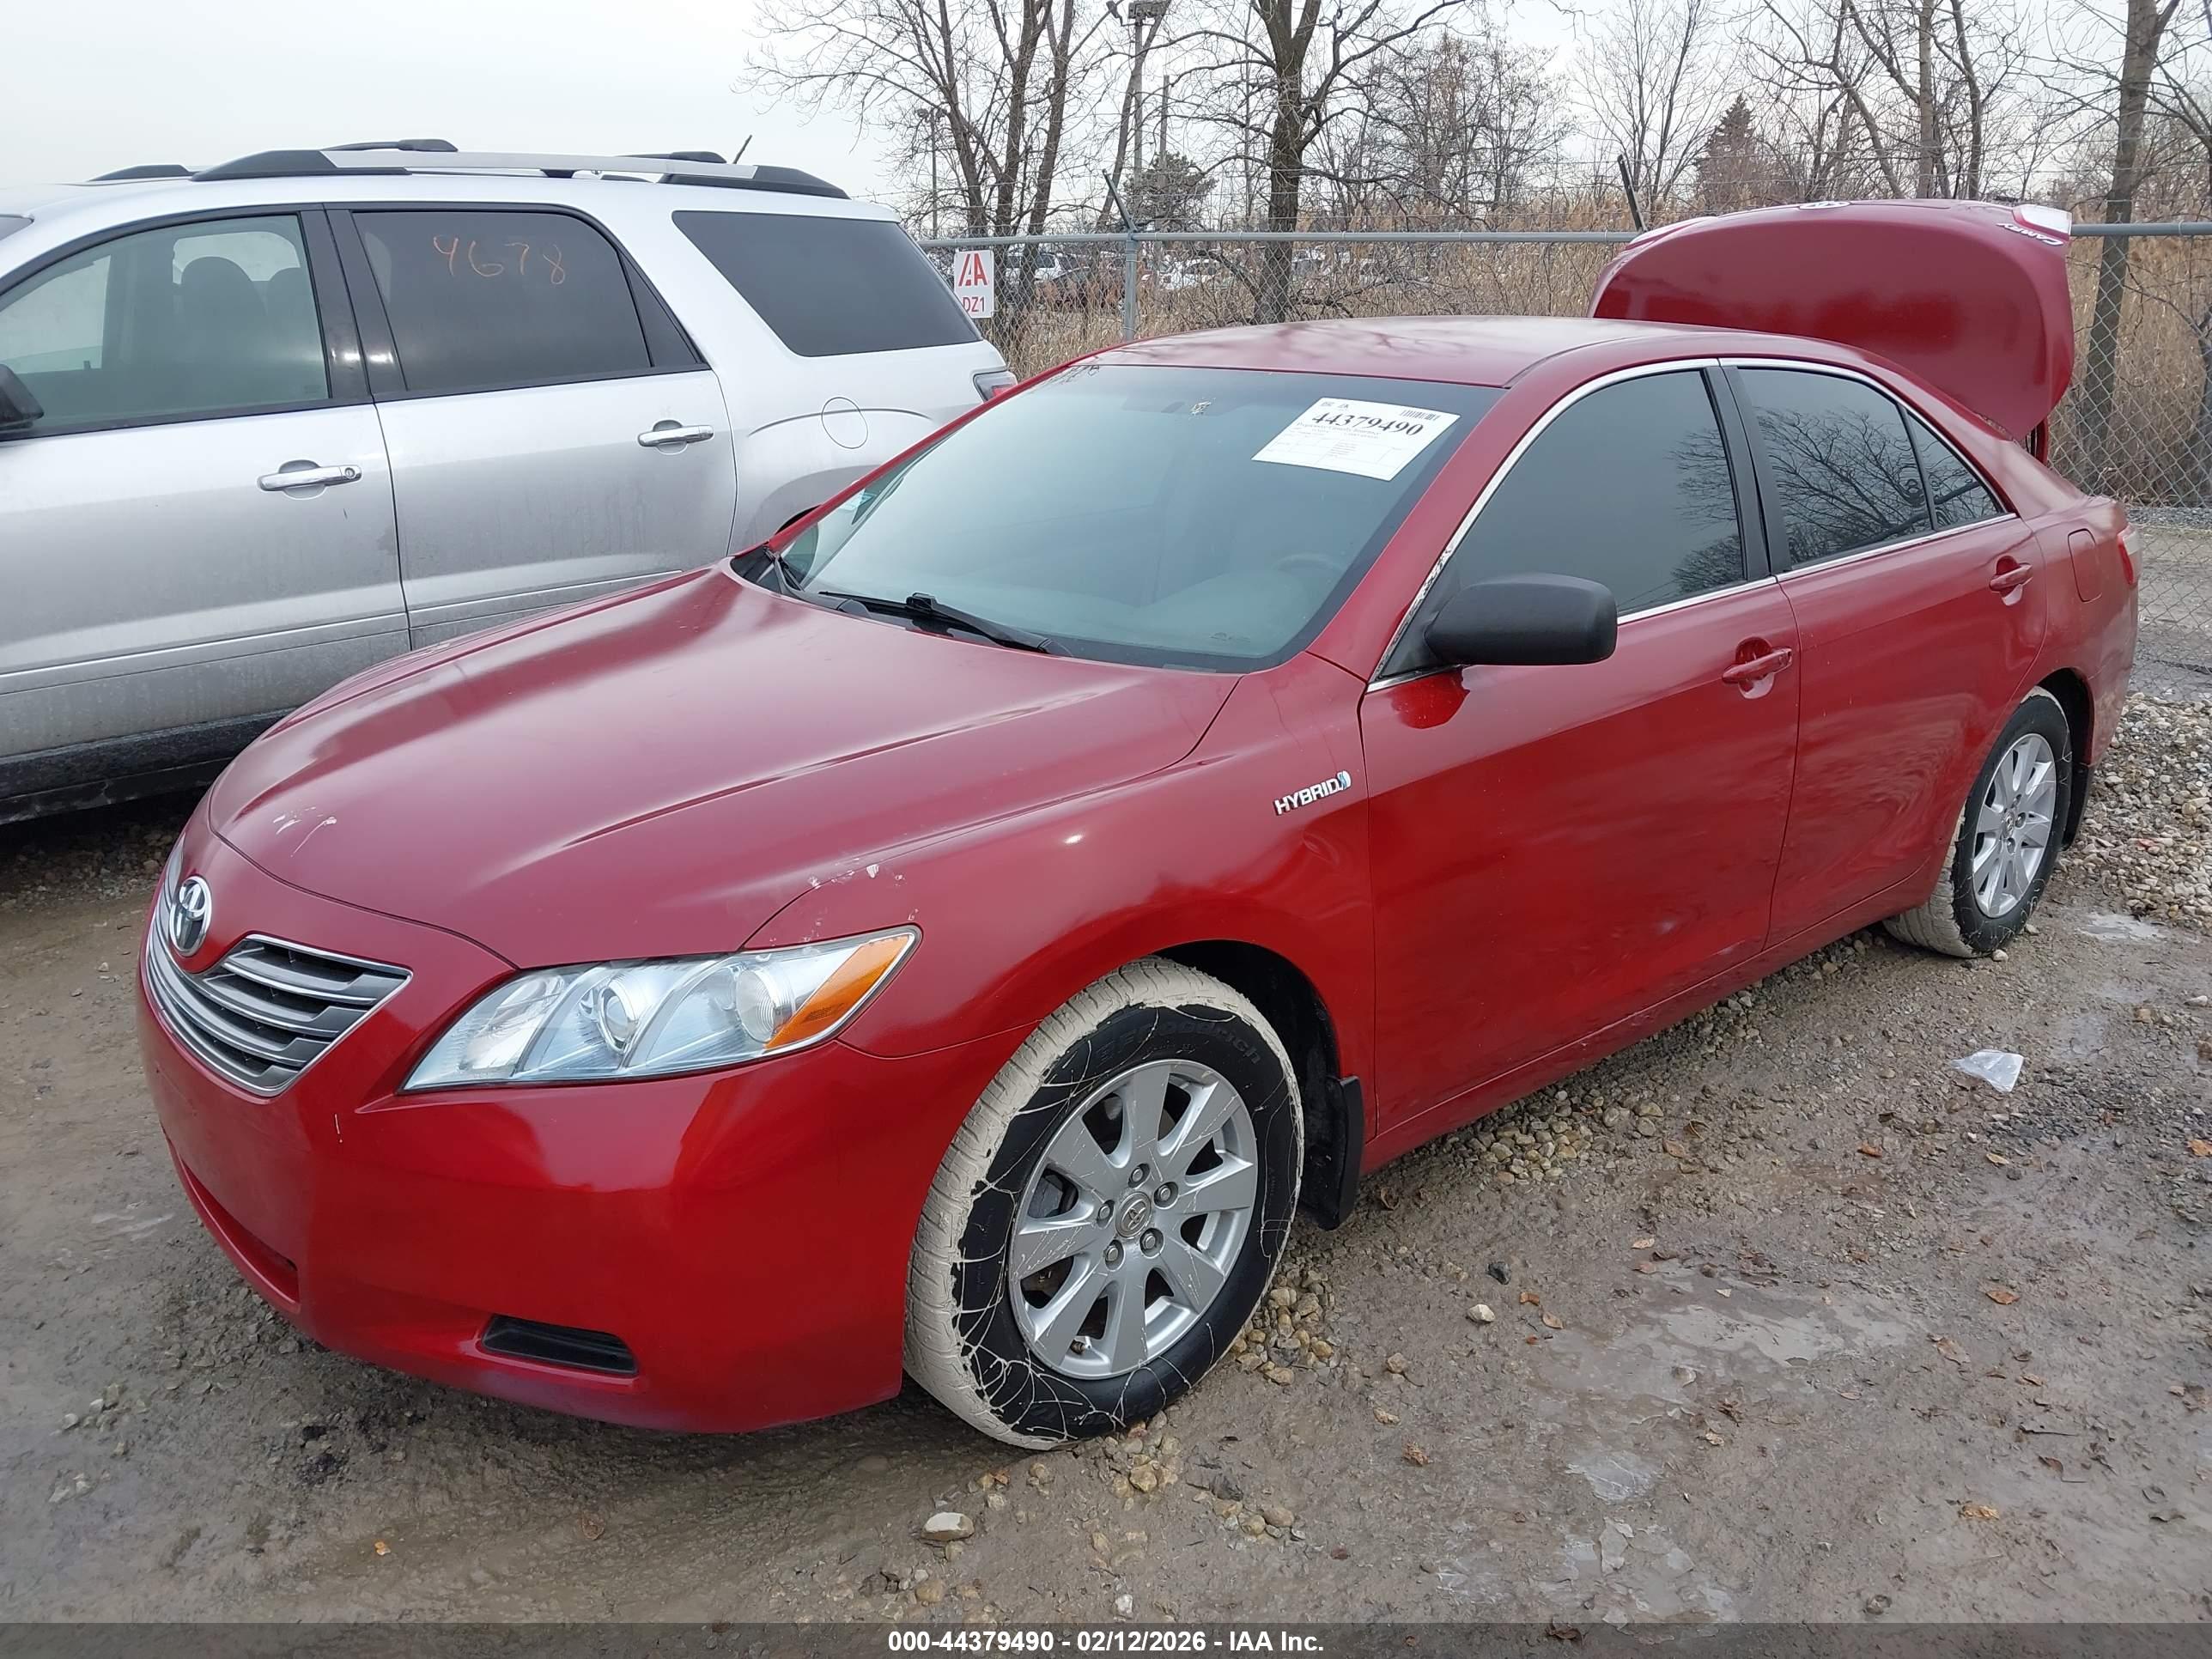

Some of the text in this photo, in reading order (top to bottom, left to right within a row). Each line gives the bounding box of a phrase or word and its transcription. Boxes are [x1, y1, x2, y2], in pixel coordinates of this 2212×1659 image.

[433, 234, 566, 284] 4678
[963, 297, 985, 313] DZ1
[1311, 412, 1424, 436] 44379490
[1274, 778, 1340, 815] HYBRID
